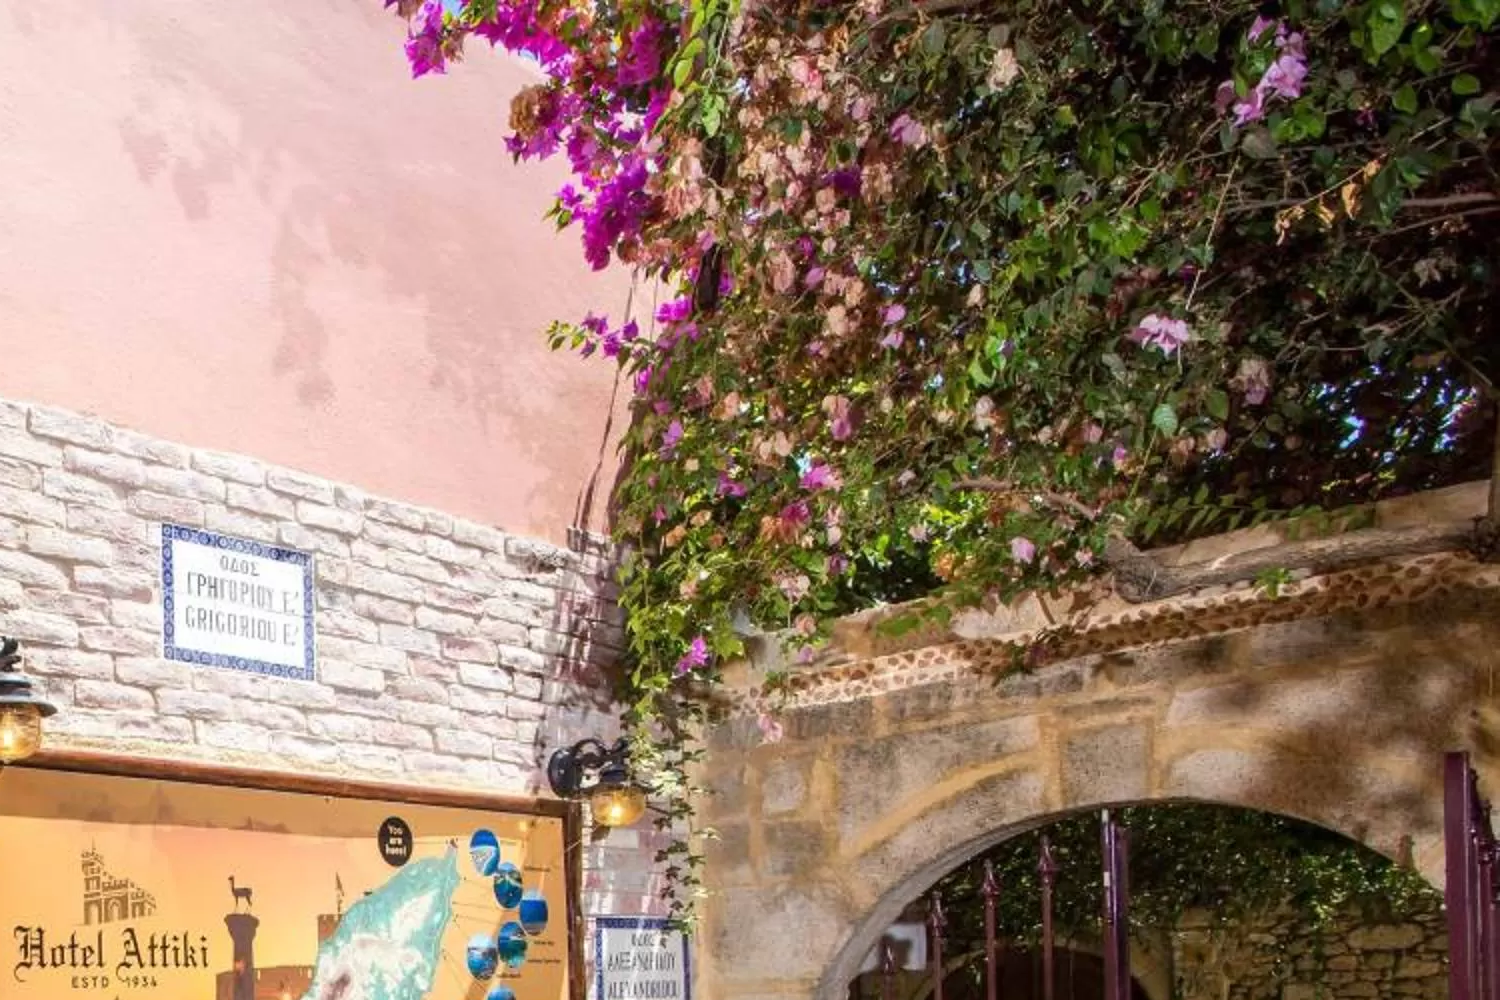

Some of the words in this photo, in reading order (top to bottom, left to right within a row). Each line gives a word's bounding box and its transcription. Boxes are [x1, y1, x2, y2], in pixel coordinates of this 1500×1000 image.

[219, 555, 260, 576] ΟΔΟΣ
[187, 571, 274, 610] ΓΡΗΓΟΡΙΟΥ
[185, 605, 276, 642] GRIGORIOU
[13, 925, 106, 982] Hotel
[115, 927, 209, 982] Attiki
[71, 975, 110, 989] ESTD
[125, 975, 158, 988] 1934
